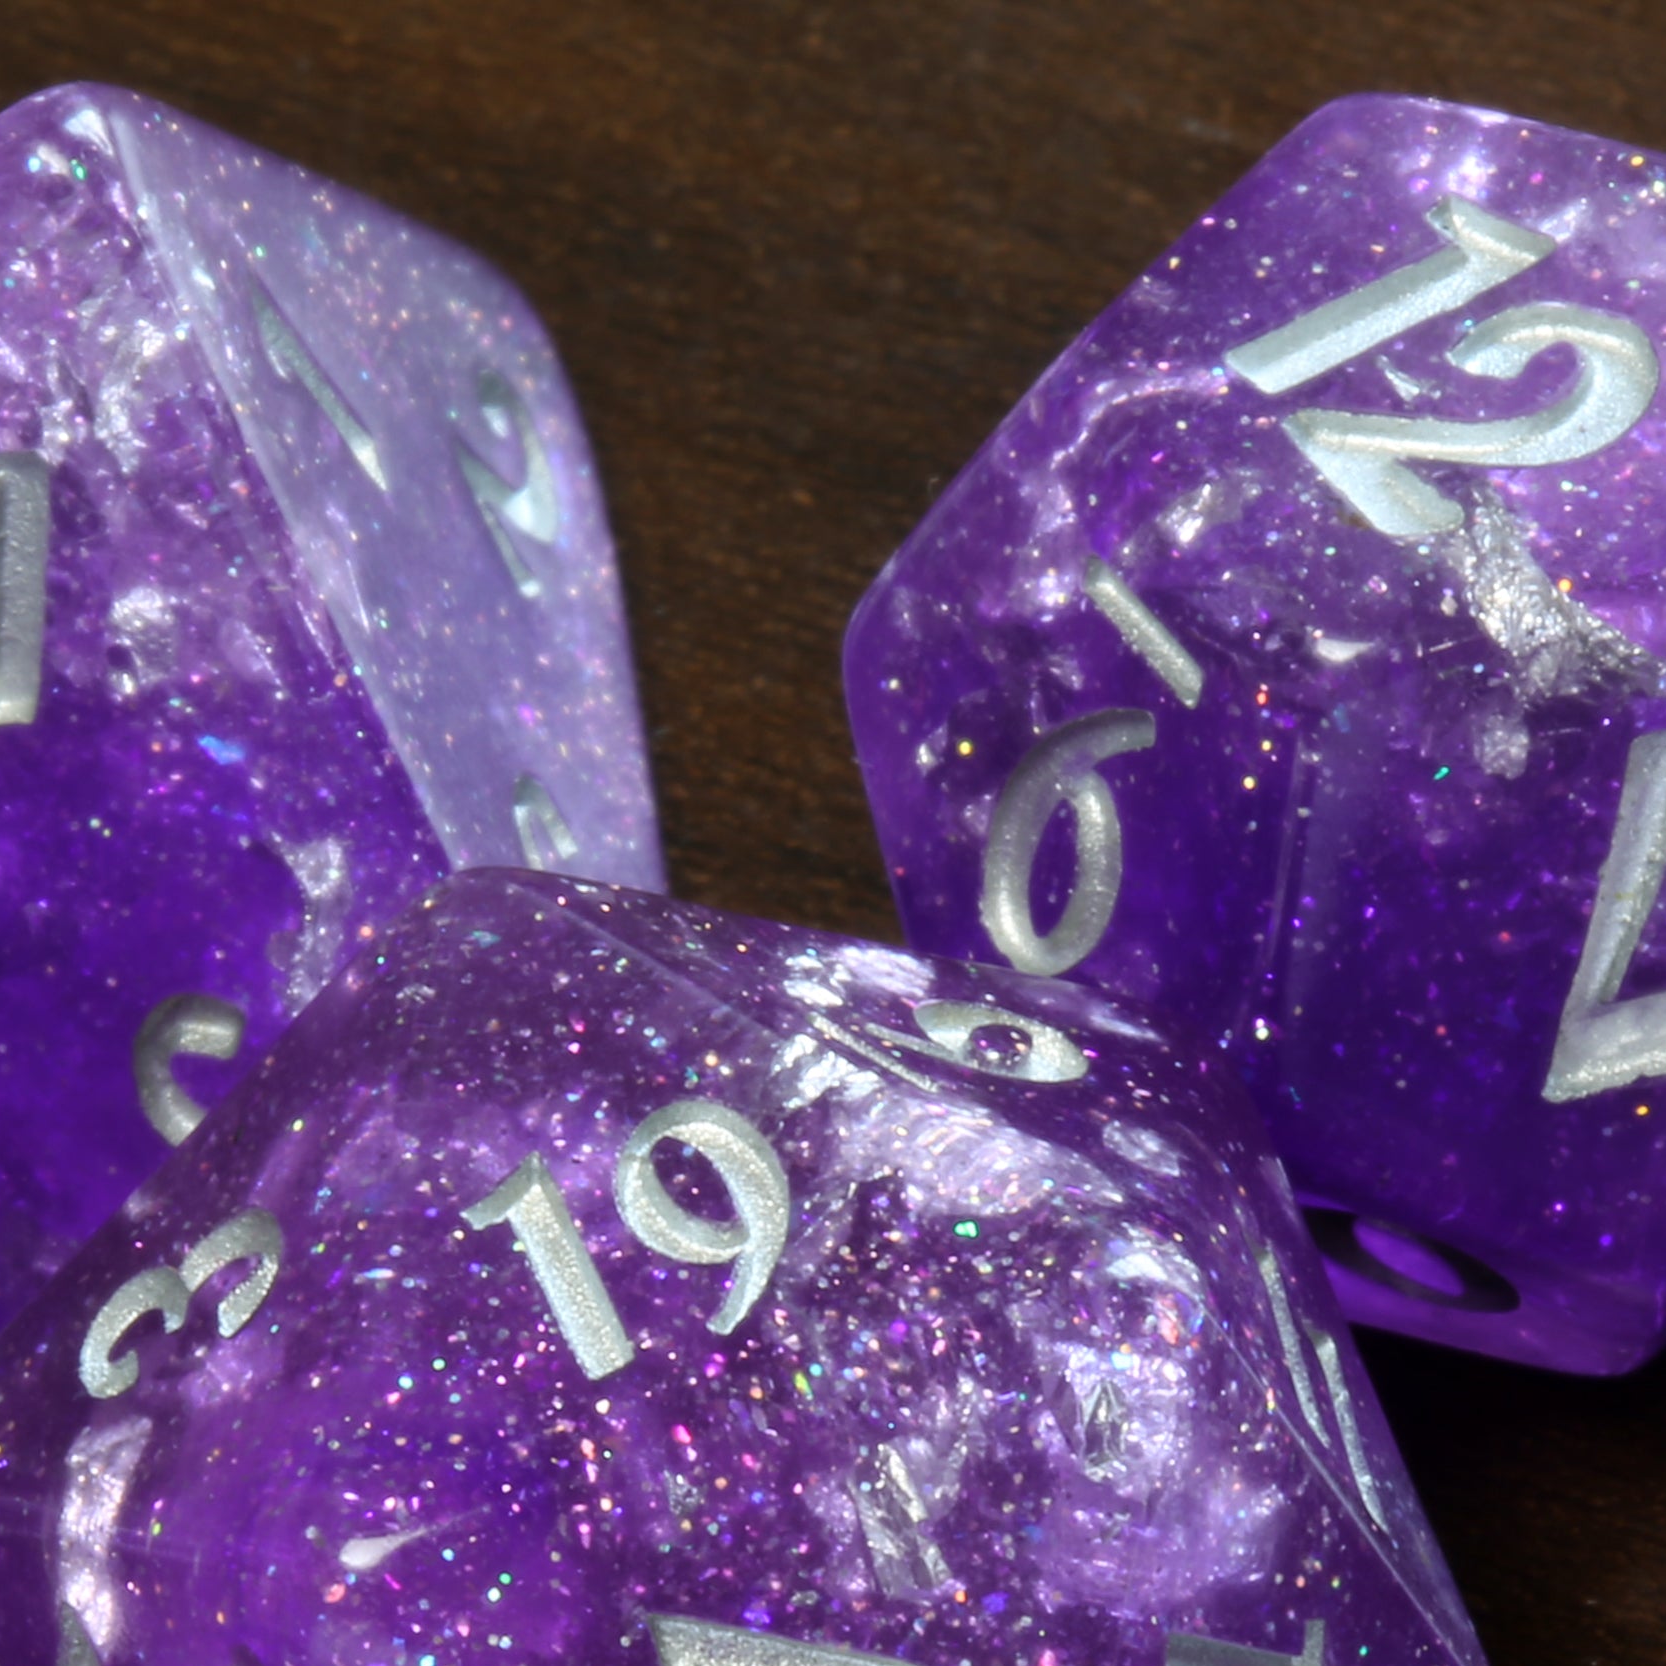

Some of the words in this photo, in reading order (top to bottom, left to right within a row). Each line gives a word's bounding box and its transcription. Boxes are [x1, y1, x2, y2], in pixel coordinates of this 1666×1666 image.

[1222, 195, 1661, 537] 12
[79, 1208, 282, 1402] 3
[462, 1099, 790, 1381] 19
